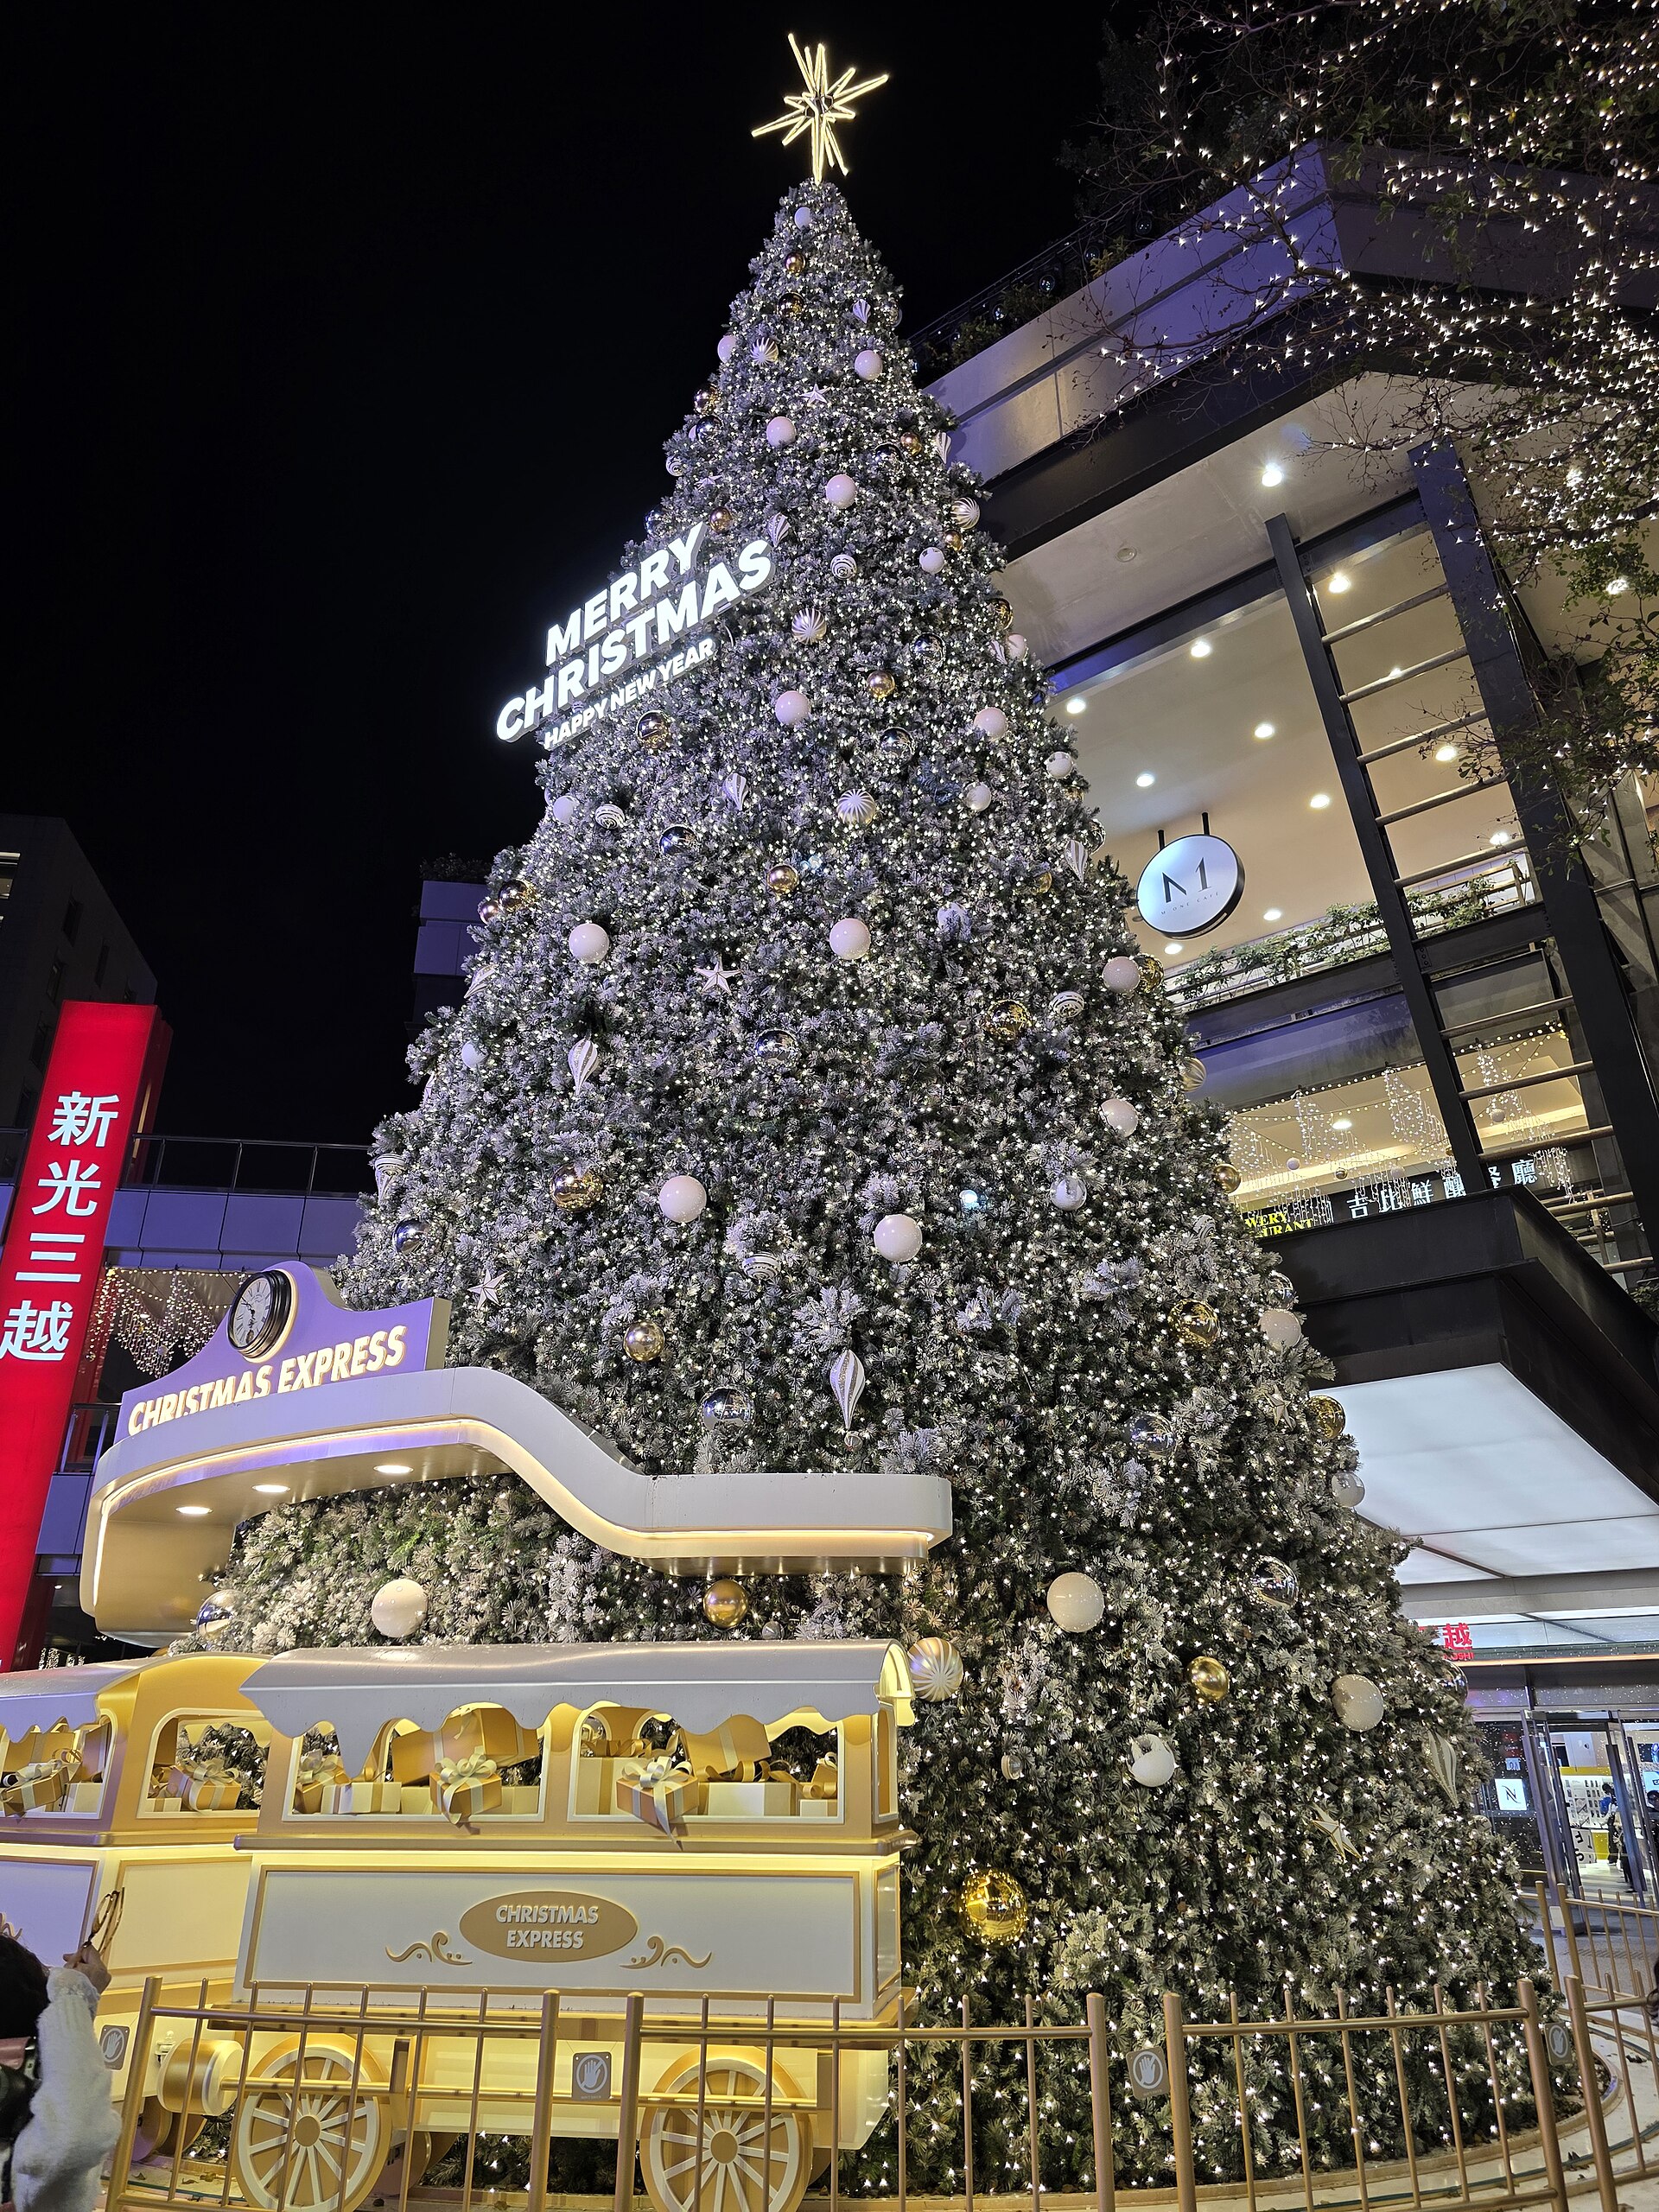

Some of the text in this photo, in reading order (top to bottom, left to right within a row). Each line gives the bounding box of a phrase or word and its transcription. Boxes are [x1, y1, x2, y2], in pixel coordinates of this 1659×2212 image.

[496, 540, 774, 742] CHRISTMAS
[545, 521, 707, 667] MERRY
[543, 639, 715, 750] HAPPY NEW YEAR
[0, 1091, 119, 1362] 新光三越
[128, 1325, 407, 1436] CHRISTMAS EXPRESS
[495, 1904, 599, 1926] CHRISTMAS
[506, 1929, 584, 1950] EXPRESS
